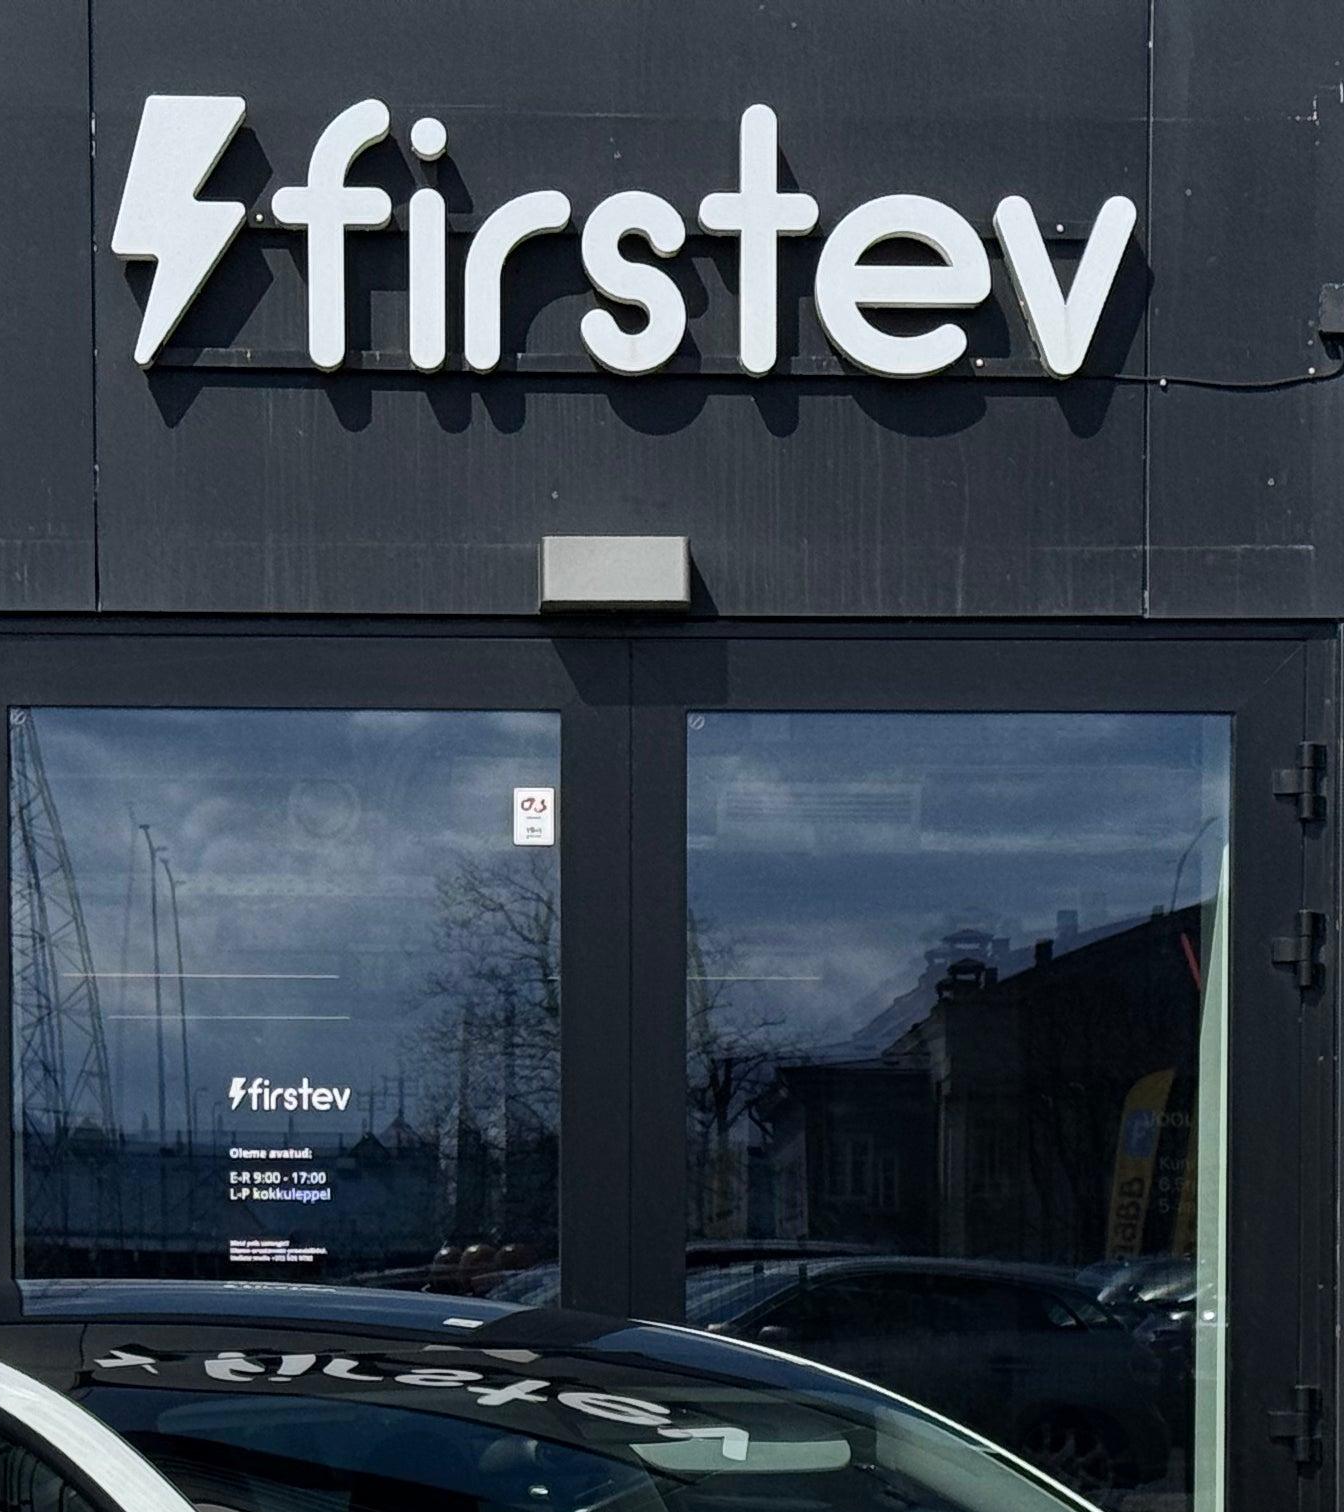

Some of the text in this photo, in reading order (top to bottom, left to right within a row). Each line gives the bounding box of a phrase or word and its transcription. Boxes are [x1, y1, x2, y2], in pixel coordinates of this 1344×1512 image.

[271, 98, 1137, 378] firstev
[247, 1077, 351, 1111] firstev
[229, 1147, 313, 1160] Oleme avatud:
[229, 1171, 251, 1184] E-R
[253, 1171, 281, 1184] 9:00
[291, 1171, 327, 1184] 17:00
[229, 1187, 331, 1204] L-P kokkuleppel
